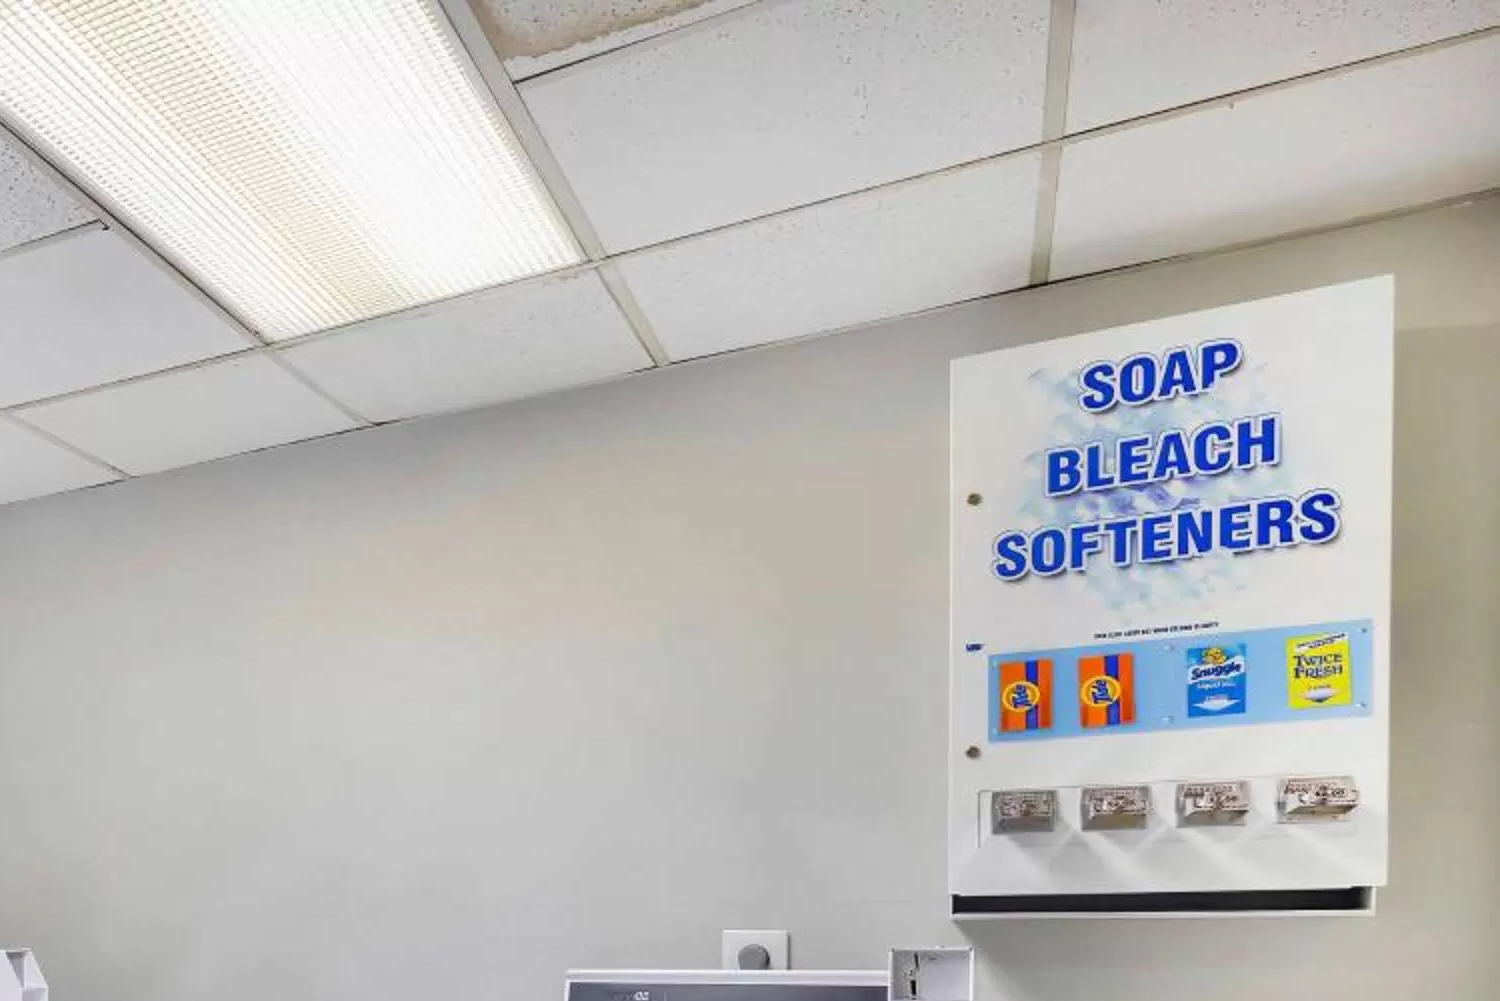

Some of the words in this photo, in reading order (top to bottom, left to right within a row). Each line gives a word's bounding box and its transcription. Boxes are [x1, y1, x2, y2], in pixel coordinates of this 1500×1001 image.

[1080, 339, 1241, 411] SOAP
[1045, 415, 1279, 496] BLEACH
[994, 490, 1340, 579] SOFTENERS
[1191, 661, 1242, 680] Snuggle
[1293, 652, 1342, 667] TWICE
[1293, 664, 1343, 679] FRESH
